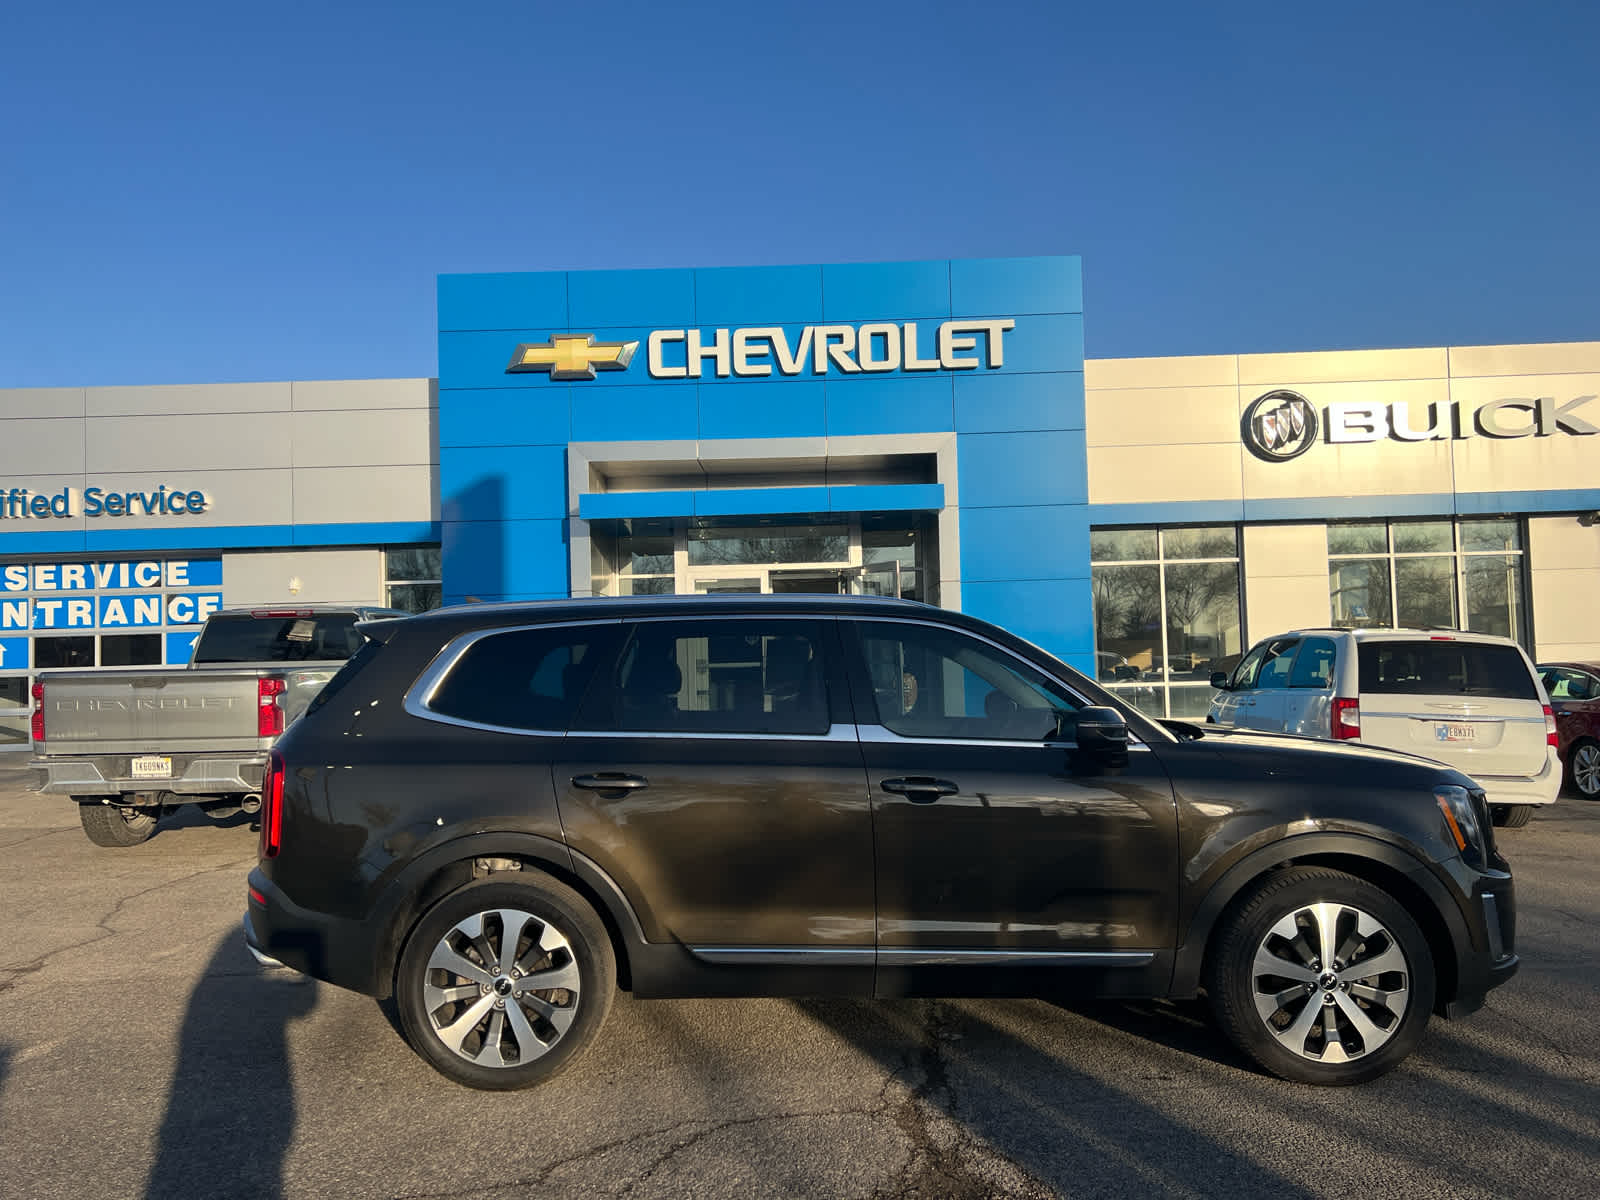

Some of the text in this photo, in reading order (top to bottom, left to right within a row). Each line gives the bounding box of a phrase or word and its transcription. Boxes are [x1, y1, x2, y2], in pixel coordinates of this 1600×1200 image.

[647, 319, 1016, 378] CHEVROLET
[1324, 394, 1600, 443] BUICK
[83, 484, 205, 517] Service
[4, 561, 189, 591] SERVICE
